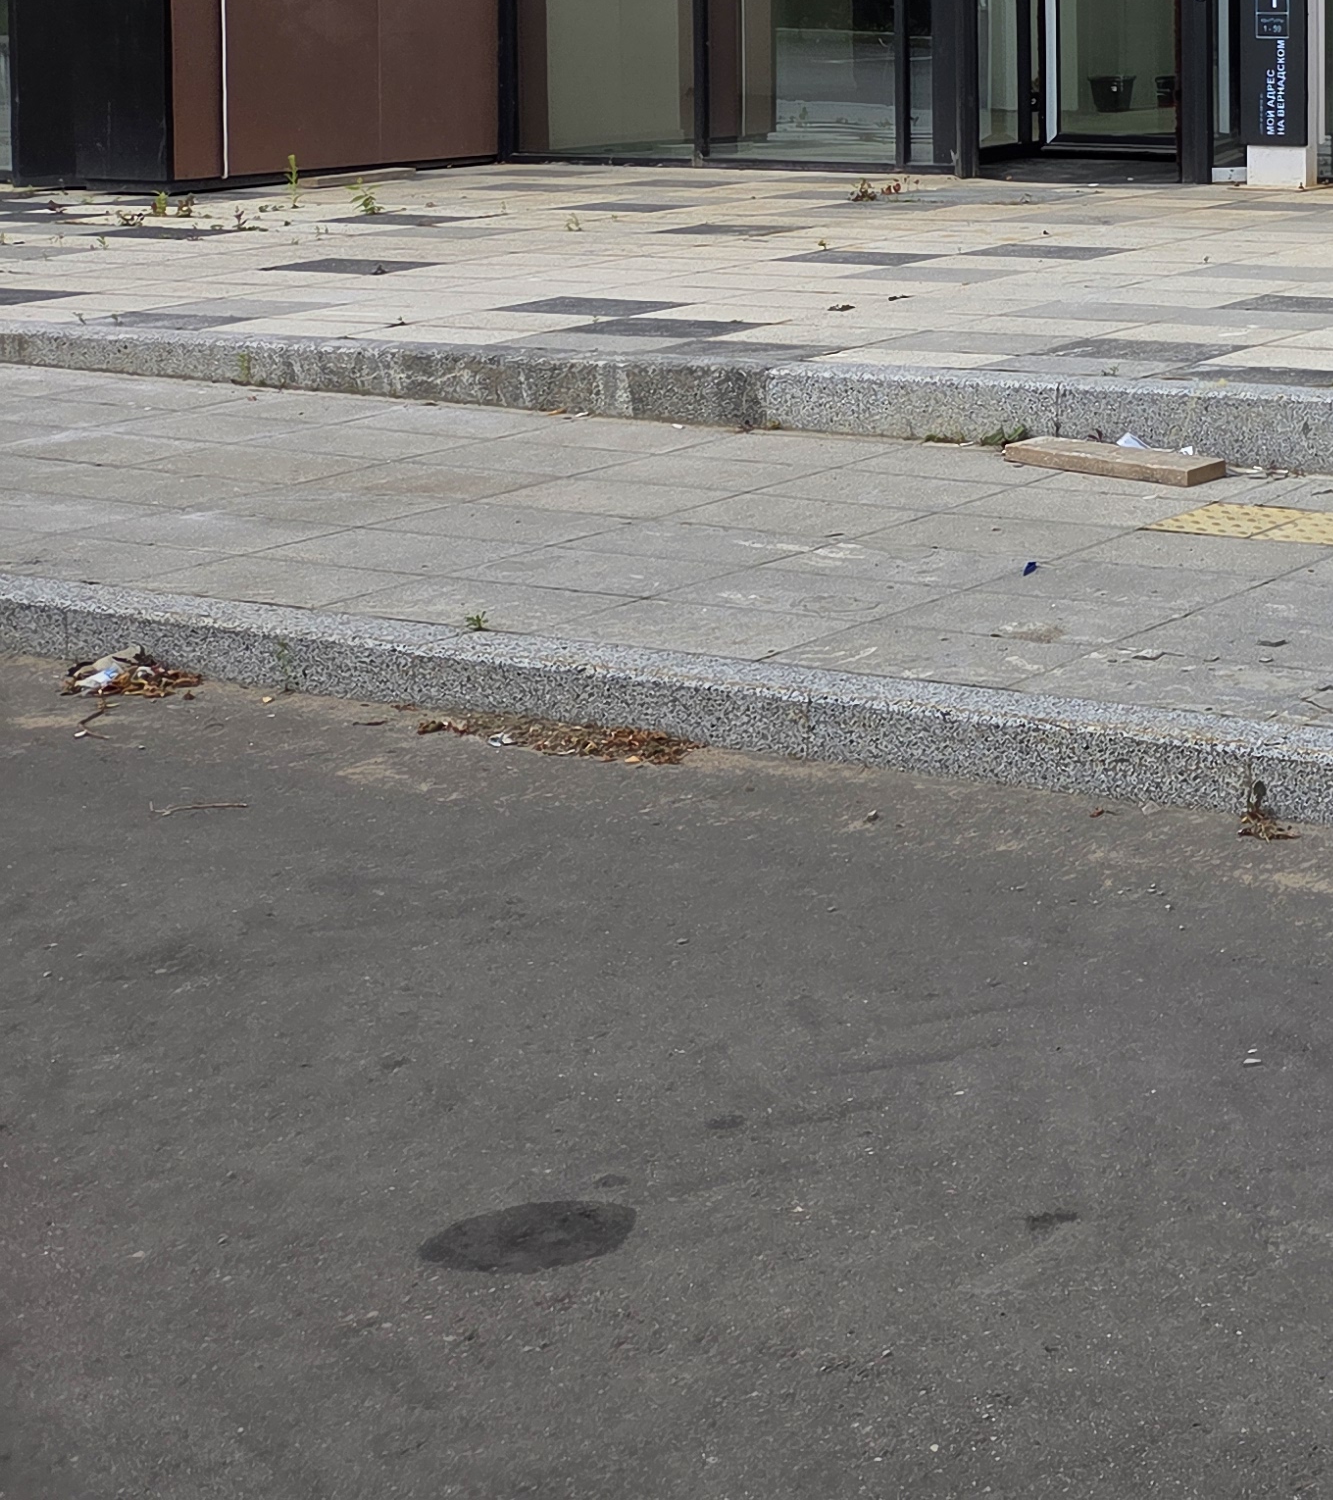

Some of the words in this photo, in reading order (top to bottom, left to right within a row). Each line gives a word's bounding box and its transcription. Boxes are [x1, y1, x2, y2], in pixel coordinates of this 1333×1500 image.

[1266, 69, 1276, 108] АДРЕС
[1277, 39, 1287, 117] ВЕРНАДСКОМ
[1265, 110, 1276, 135] МОЙ
[1277, 119, 1285, 135] НА
